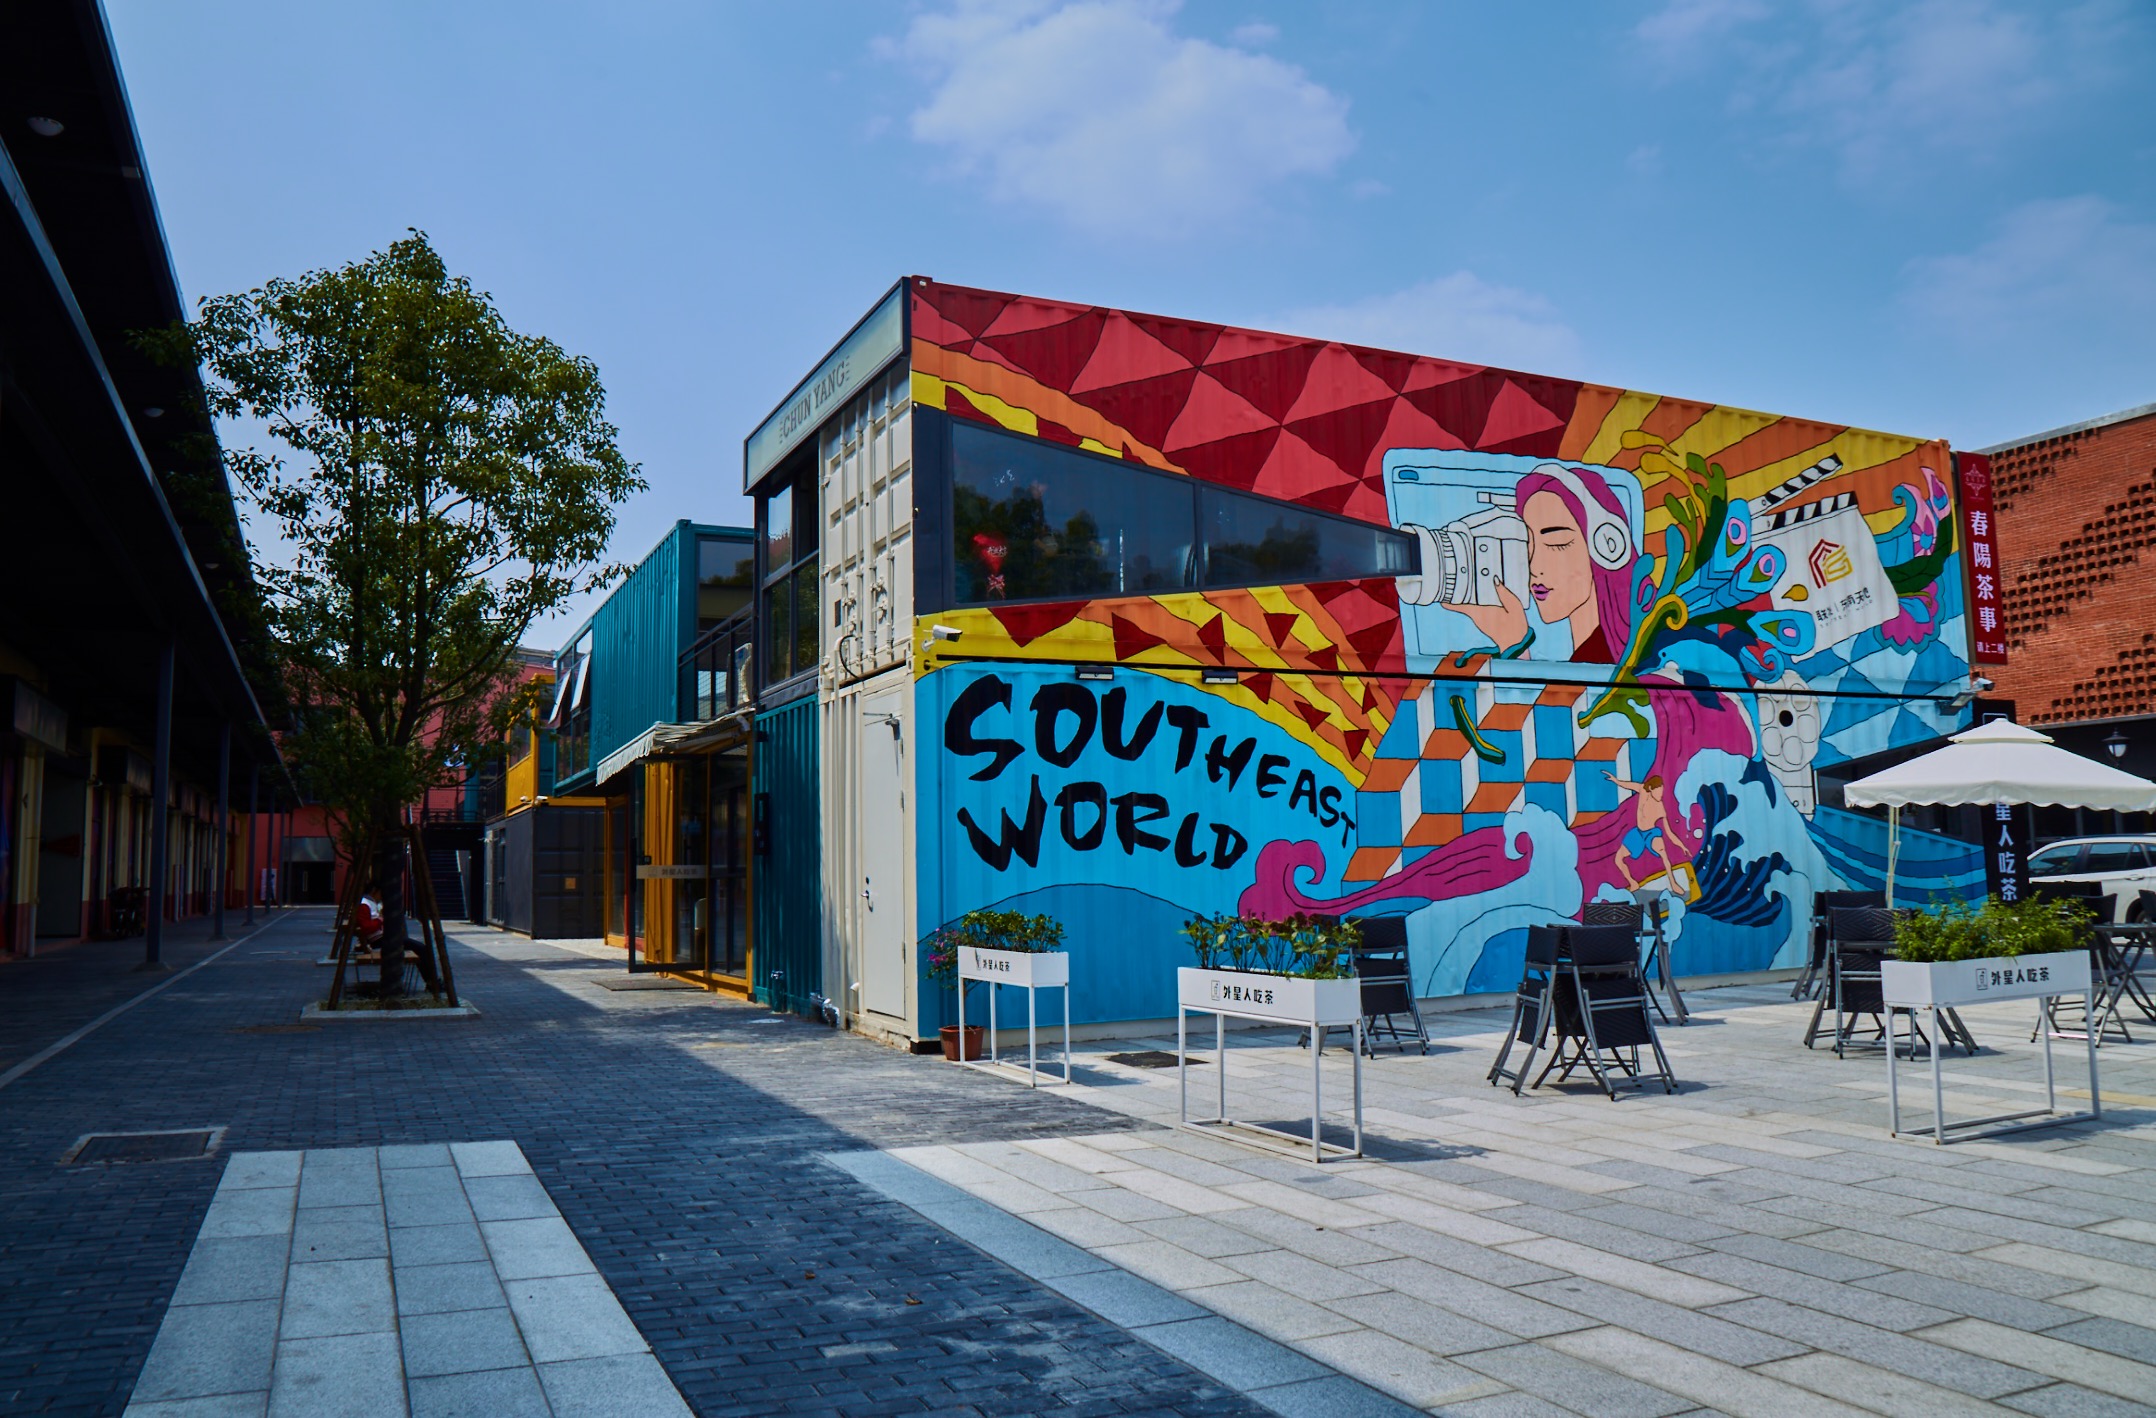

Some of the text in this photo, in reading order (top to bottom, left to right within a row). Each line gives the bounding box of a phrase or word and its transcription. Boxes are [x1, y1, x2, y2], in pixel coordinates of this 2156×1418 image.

[783, 361, 845, 438] CHUN YANG
[1969, 511, 1997, 632] 春陽茶事
[944, 673, 1356, 848] SOUTHEAST
[957, 774, 1248, 872] WORLD
[1223, 985, 1273, 1005] 外星人吃茶
[1991, 966, 2050, 986] 外星人吃茶
